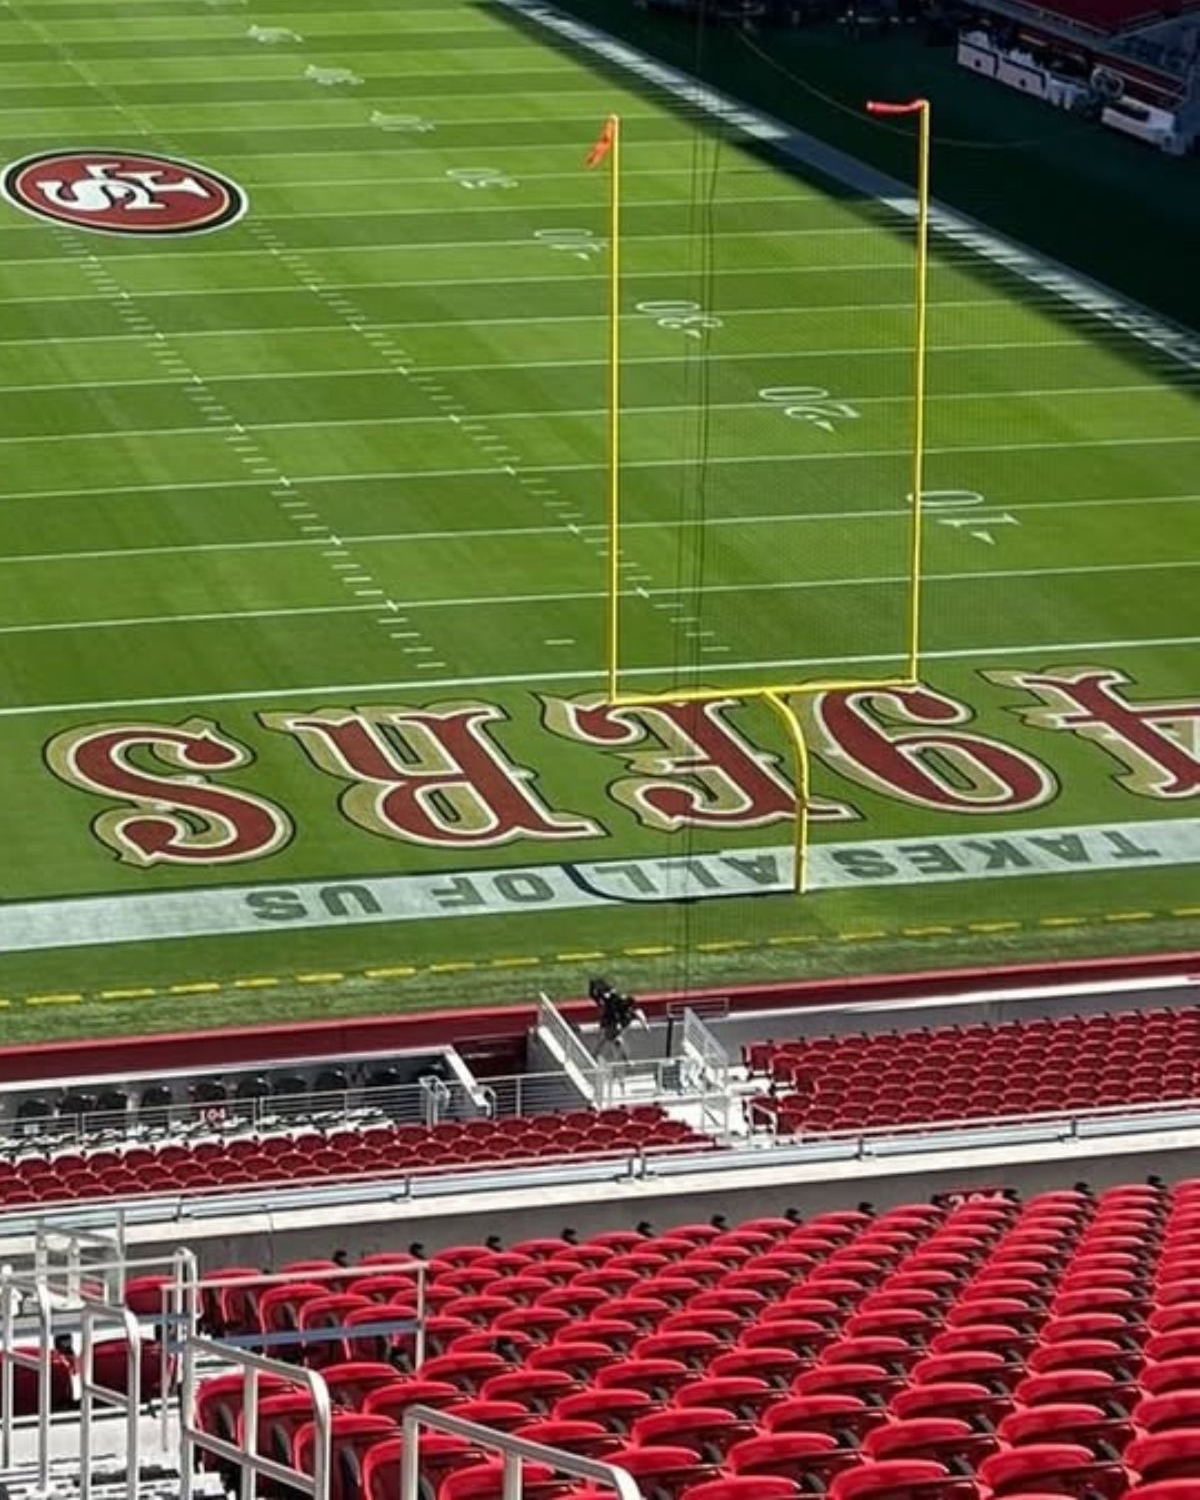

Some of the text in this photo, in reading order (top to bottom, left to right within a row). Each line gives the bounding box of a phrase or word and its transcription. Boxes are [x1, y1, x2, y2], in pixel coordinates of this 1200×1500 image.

[635, 300, 723, 329] 30
[758, 386, 861, 419] 20
[906, 490, 1021, 526] 10
[246, 829, 1160, 921] TAKES ALL OF US
